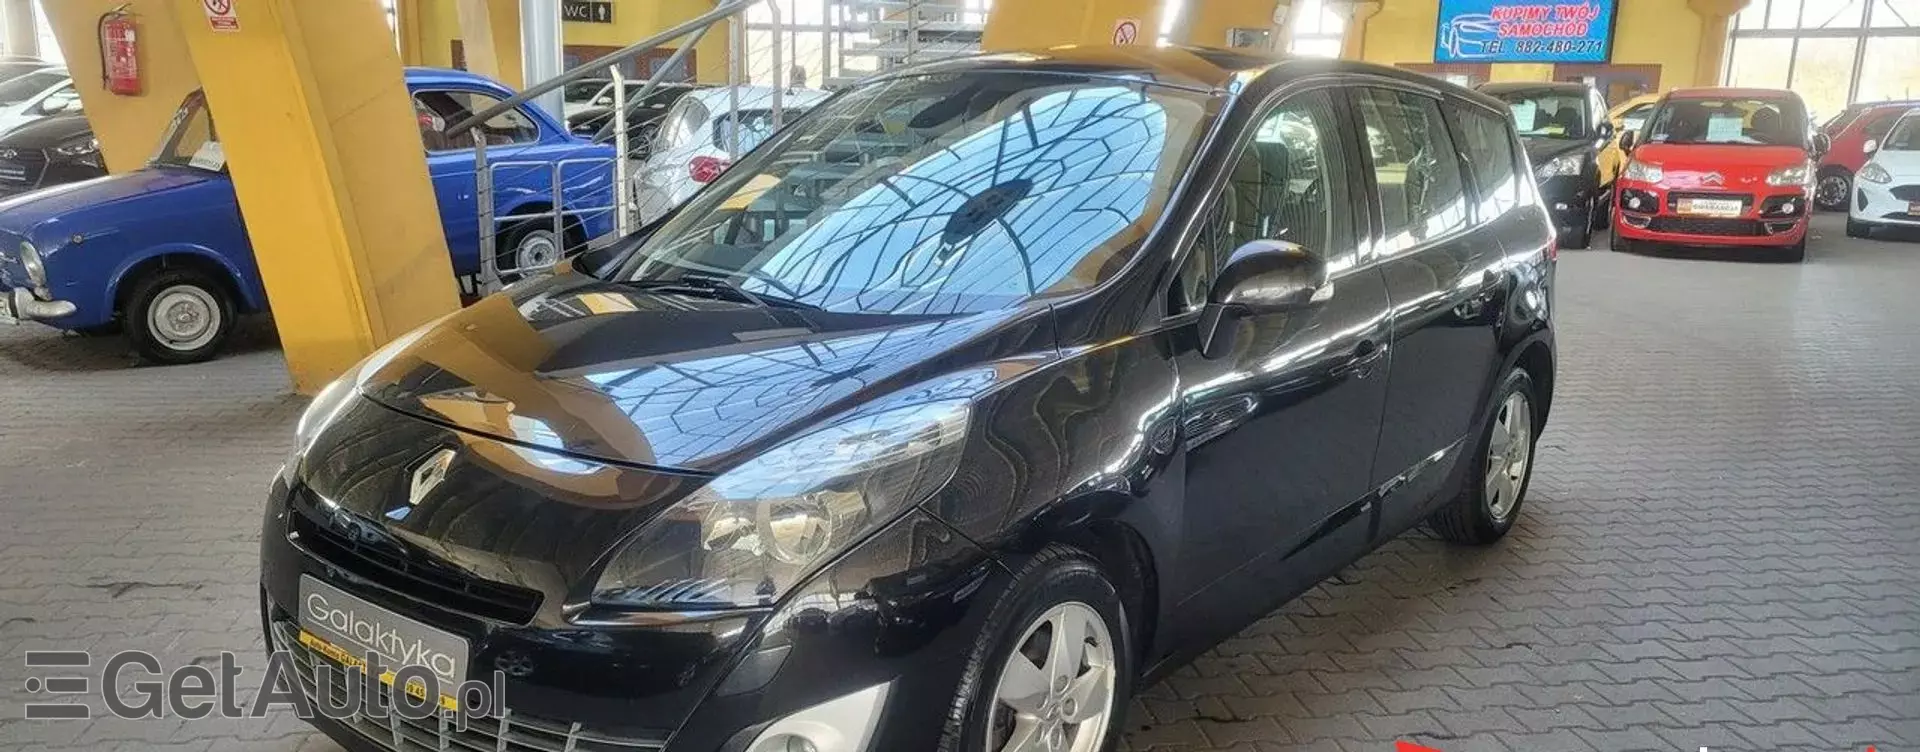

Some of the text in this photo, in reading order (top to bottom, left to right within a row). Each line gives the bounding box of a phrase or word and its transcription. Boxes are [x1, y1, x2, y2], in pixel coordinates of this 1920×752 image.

[563, 4, 587, 18] WC
[1491, 1, 1600, 21] KUPIMY TWÓJ
[1516, 40, 1602, 54] 882-480-271
[307, 593, 456, 678] Galaktyka
